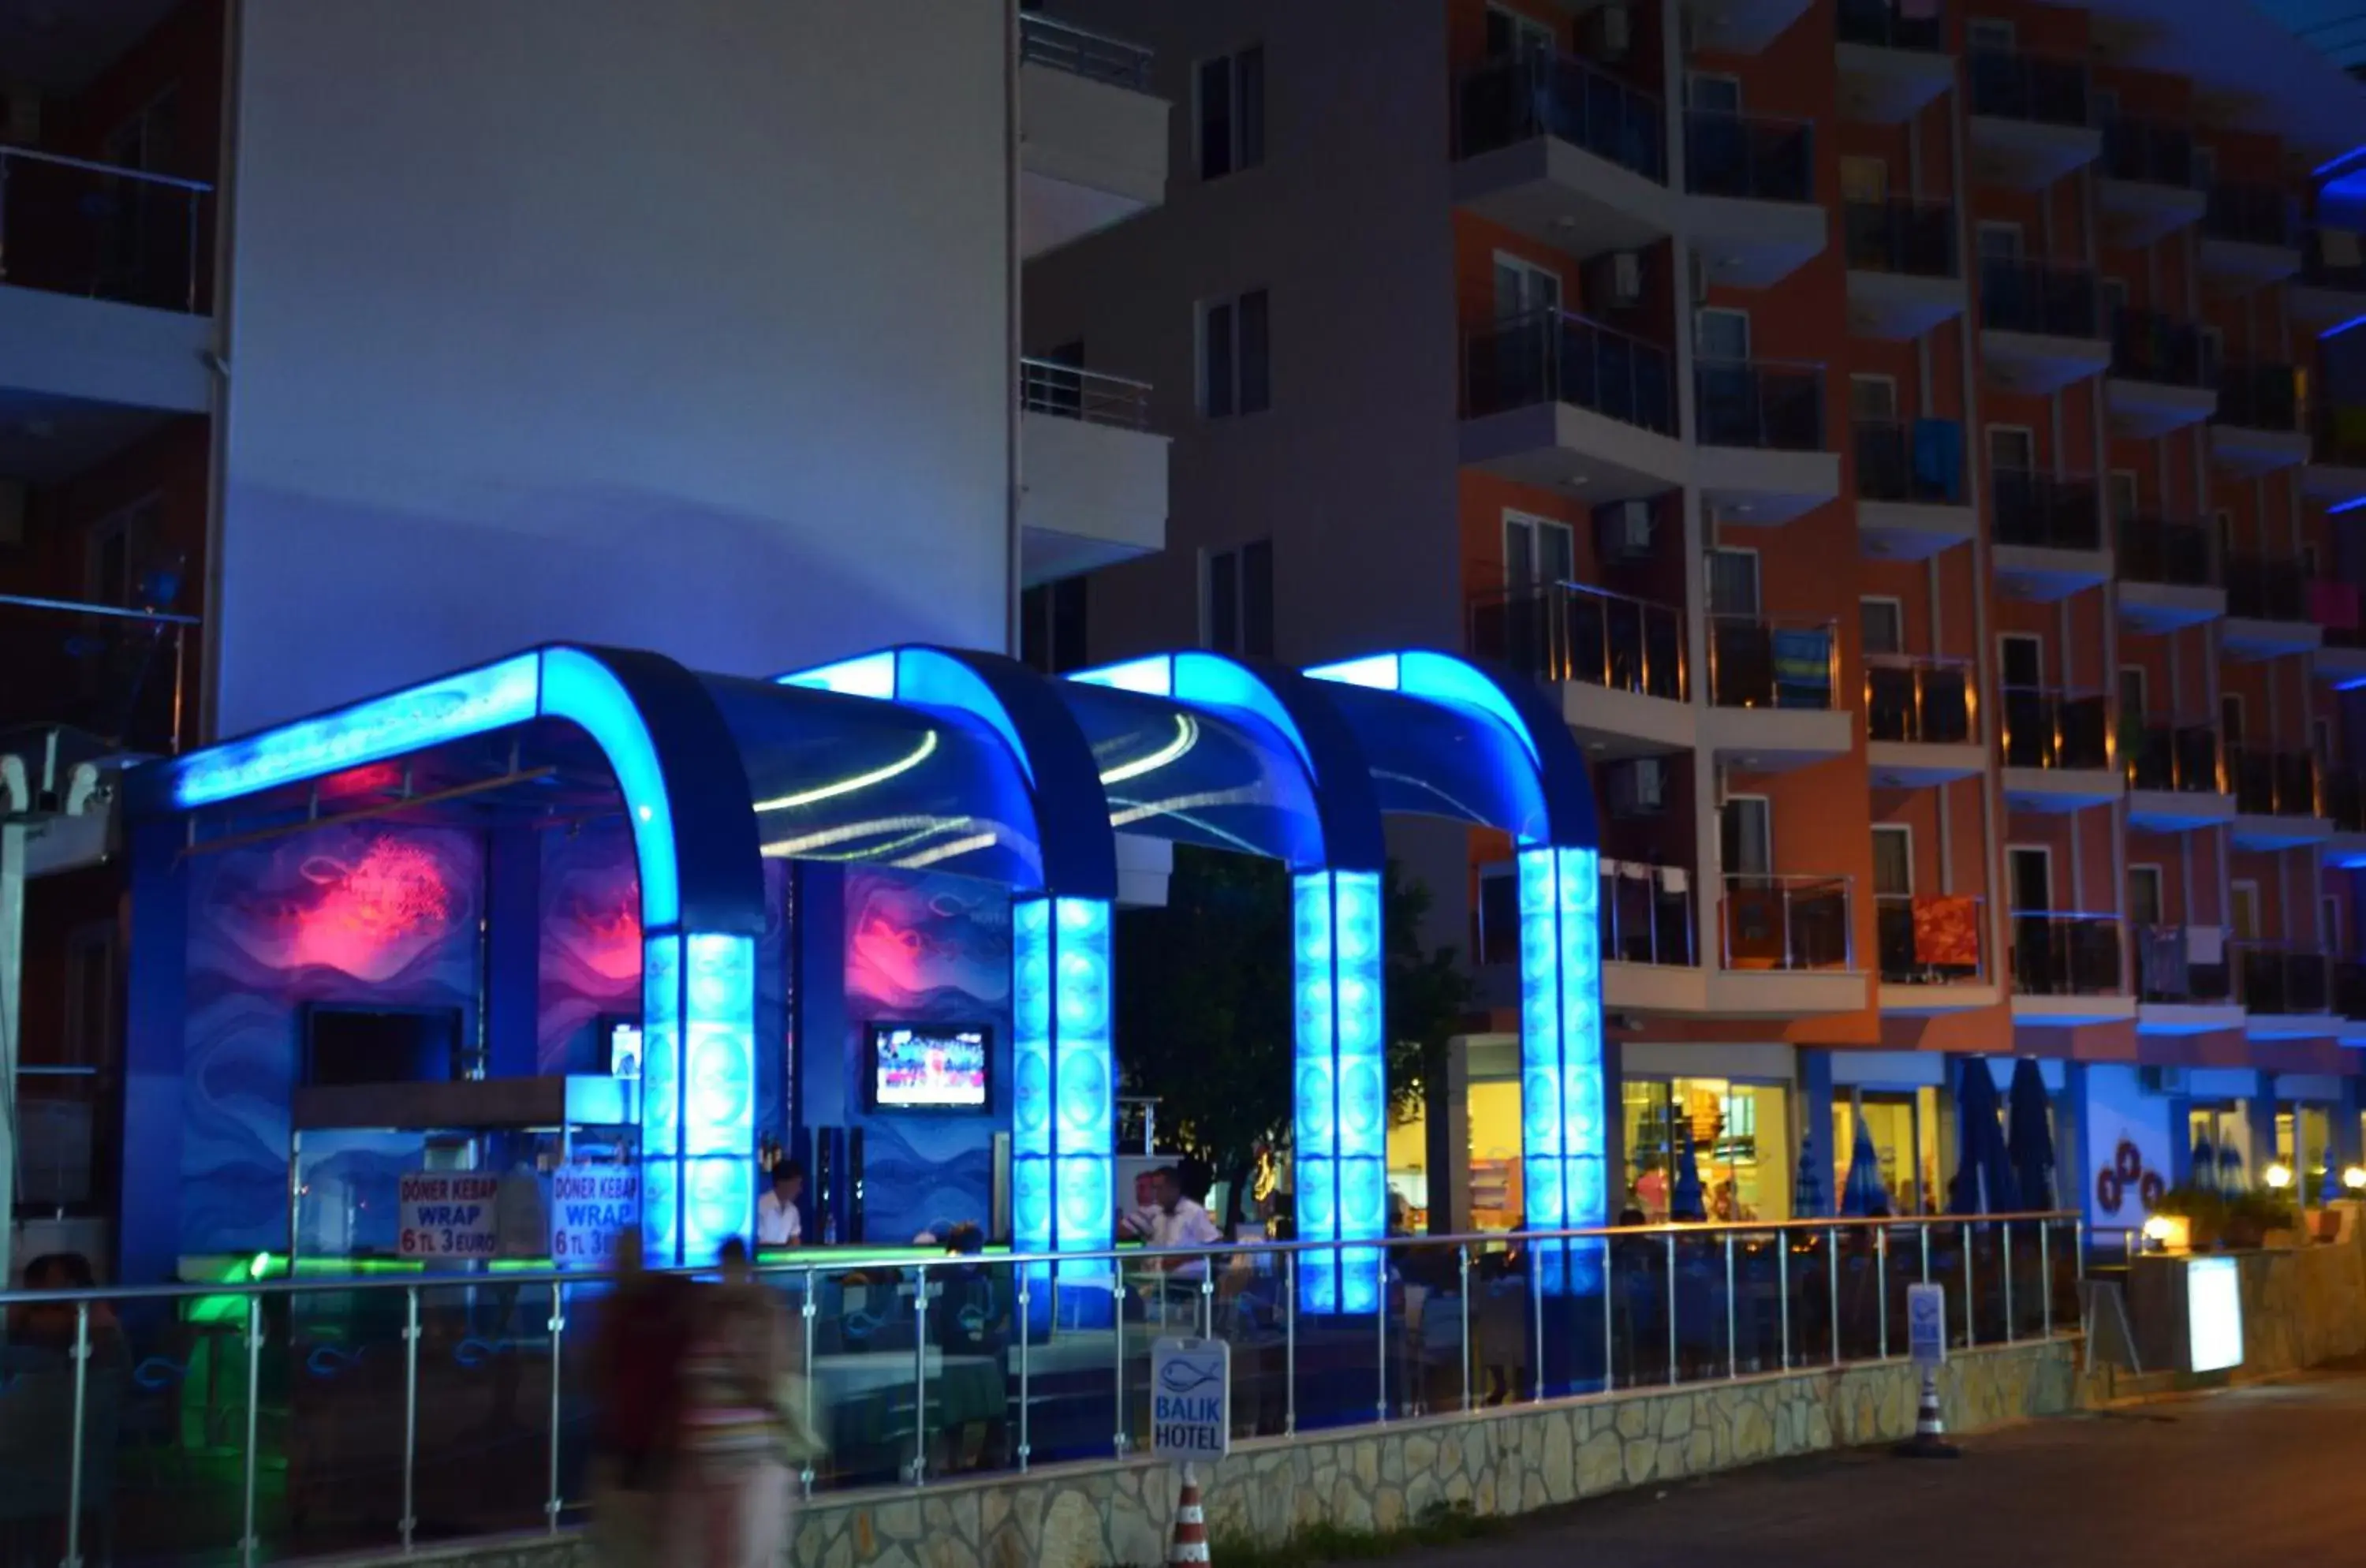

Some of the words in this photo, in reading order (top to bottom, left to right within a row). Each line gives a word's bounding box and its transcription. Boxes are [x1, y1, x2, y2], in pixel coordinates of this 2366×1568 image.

[417, 1205, 480, 1226] WRAP
[565, 1204, 631, 1227] WRAP
[401, 1228, 416, 1253] 6
[418, 1234, 435, 1253] TL
[441, 1228, 453, 1253] 3
[456, 1233, 496, 1253] EURO
[555, 1229, 567, 1255] 6
[570, 1234, 585, 1256] TL
[590, 1229, 602, 1255] 3
[1155, 1423, 1222, 1450] HOTEL
